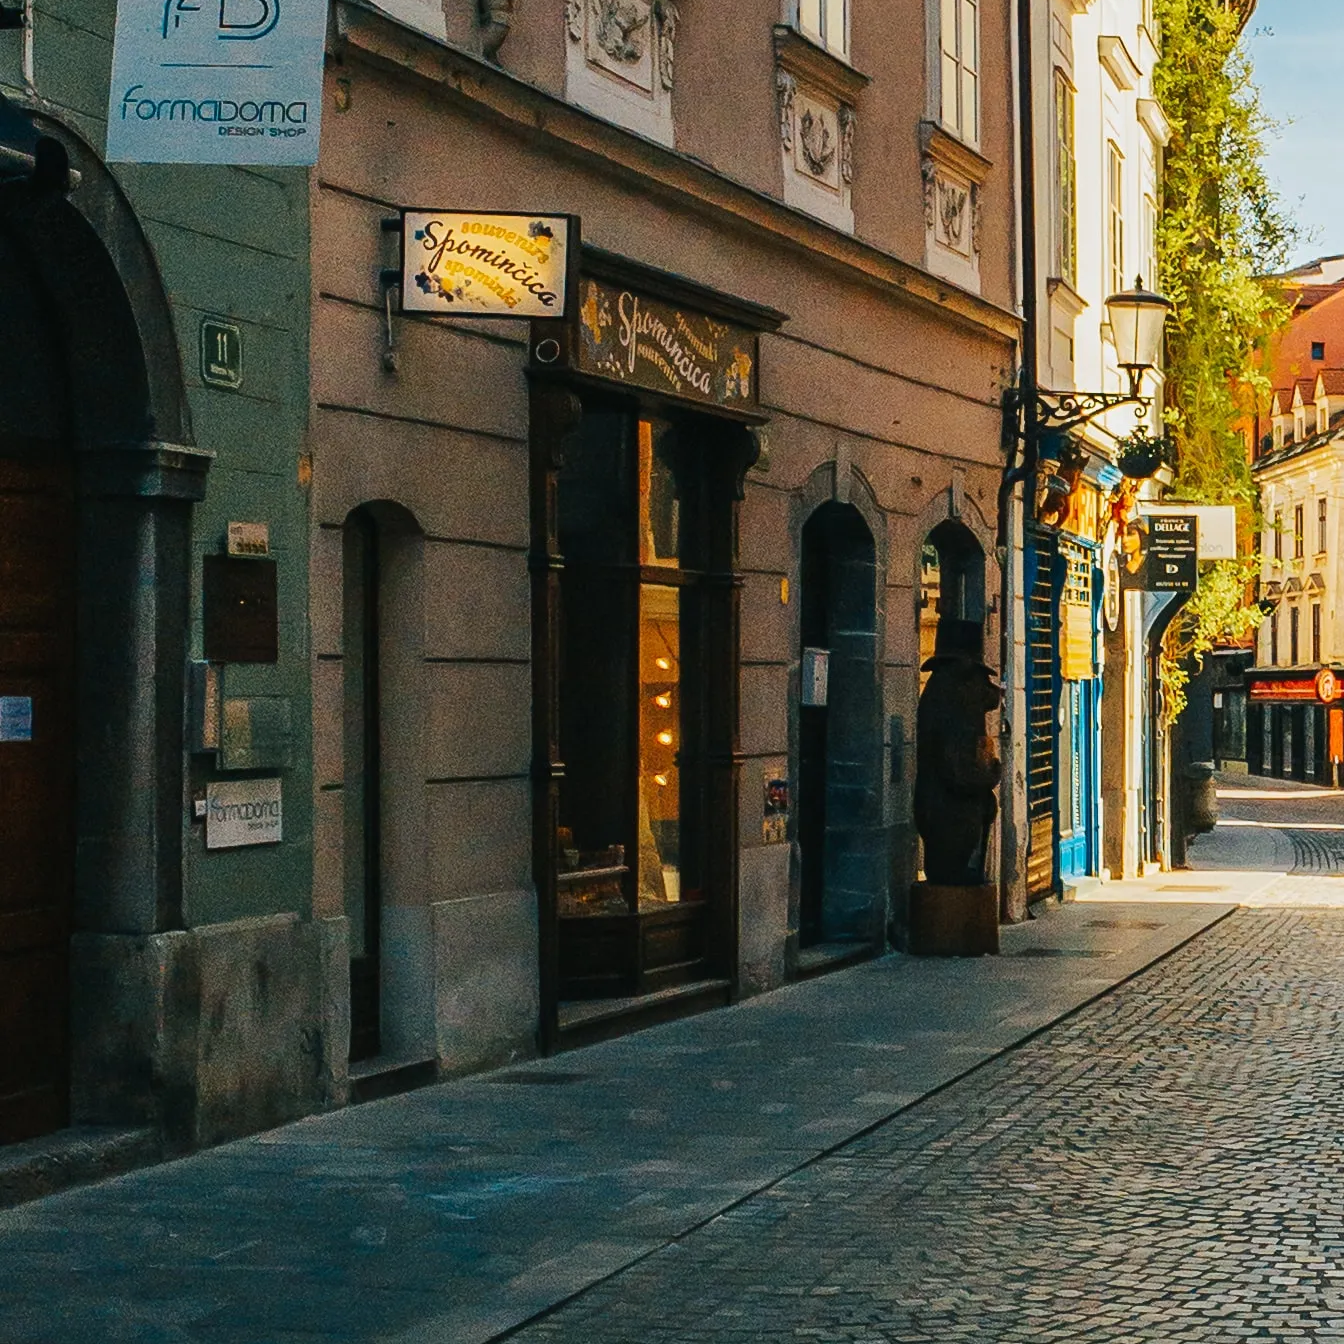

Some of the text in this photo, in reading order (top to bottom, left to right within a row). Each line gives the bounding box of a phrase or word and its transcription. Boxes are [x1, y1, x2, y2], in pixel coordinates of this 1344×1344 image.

[218, 126, 307, 138] DESIGN SHOP
[422, 220, 557, 307] Spominčica
[460, 221, 550, 265] souvenirs
[444, 258, 521, 309] spominki
[216, 332, 228, 364] 11
[618, 291, 712, 395] Spominčica
